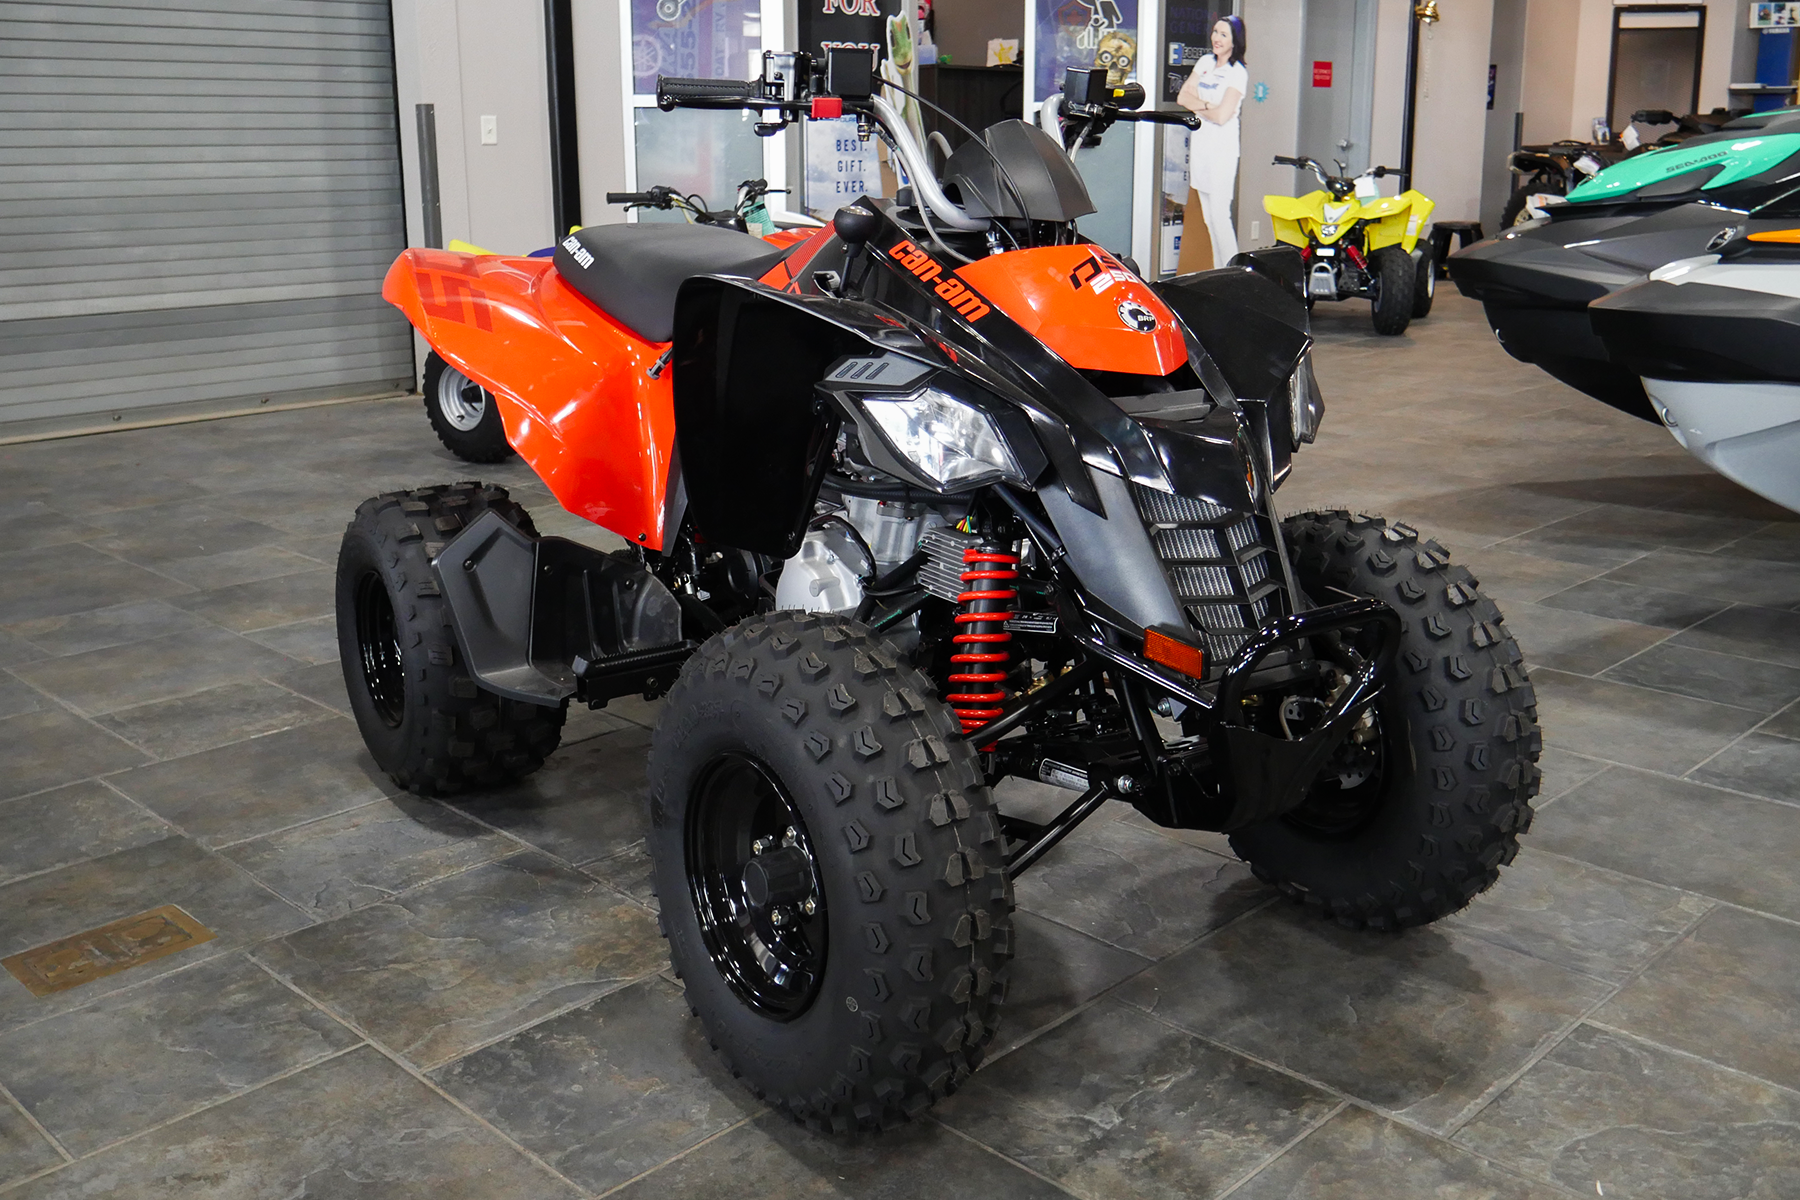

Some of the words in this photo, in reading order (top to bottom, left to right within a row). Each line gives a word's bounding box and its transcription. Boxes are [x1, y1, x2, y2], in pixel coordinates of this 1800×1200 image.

[823, 0, 880, 16] FOR
[836, 139, 868, 152] BEST.
[837, 160, 867, 173] GIFT.
[836, 180, 868, 194] EVER.
[562, 235, 595, 270] can-am
[888, 239, 991, 323] can-am
